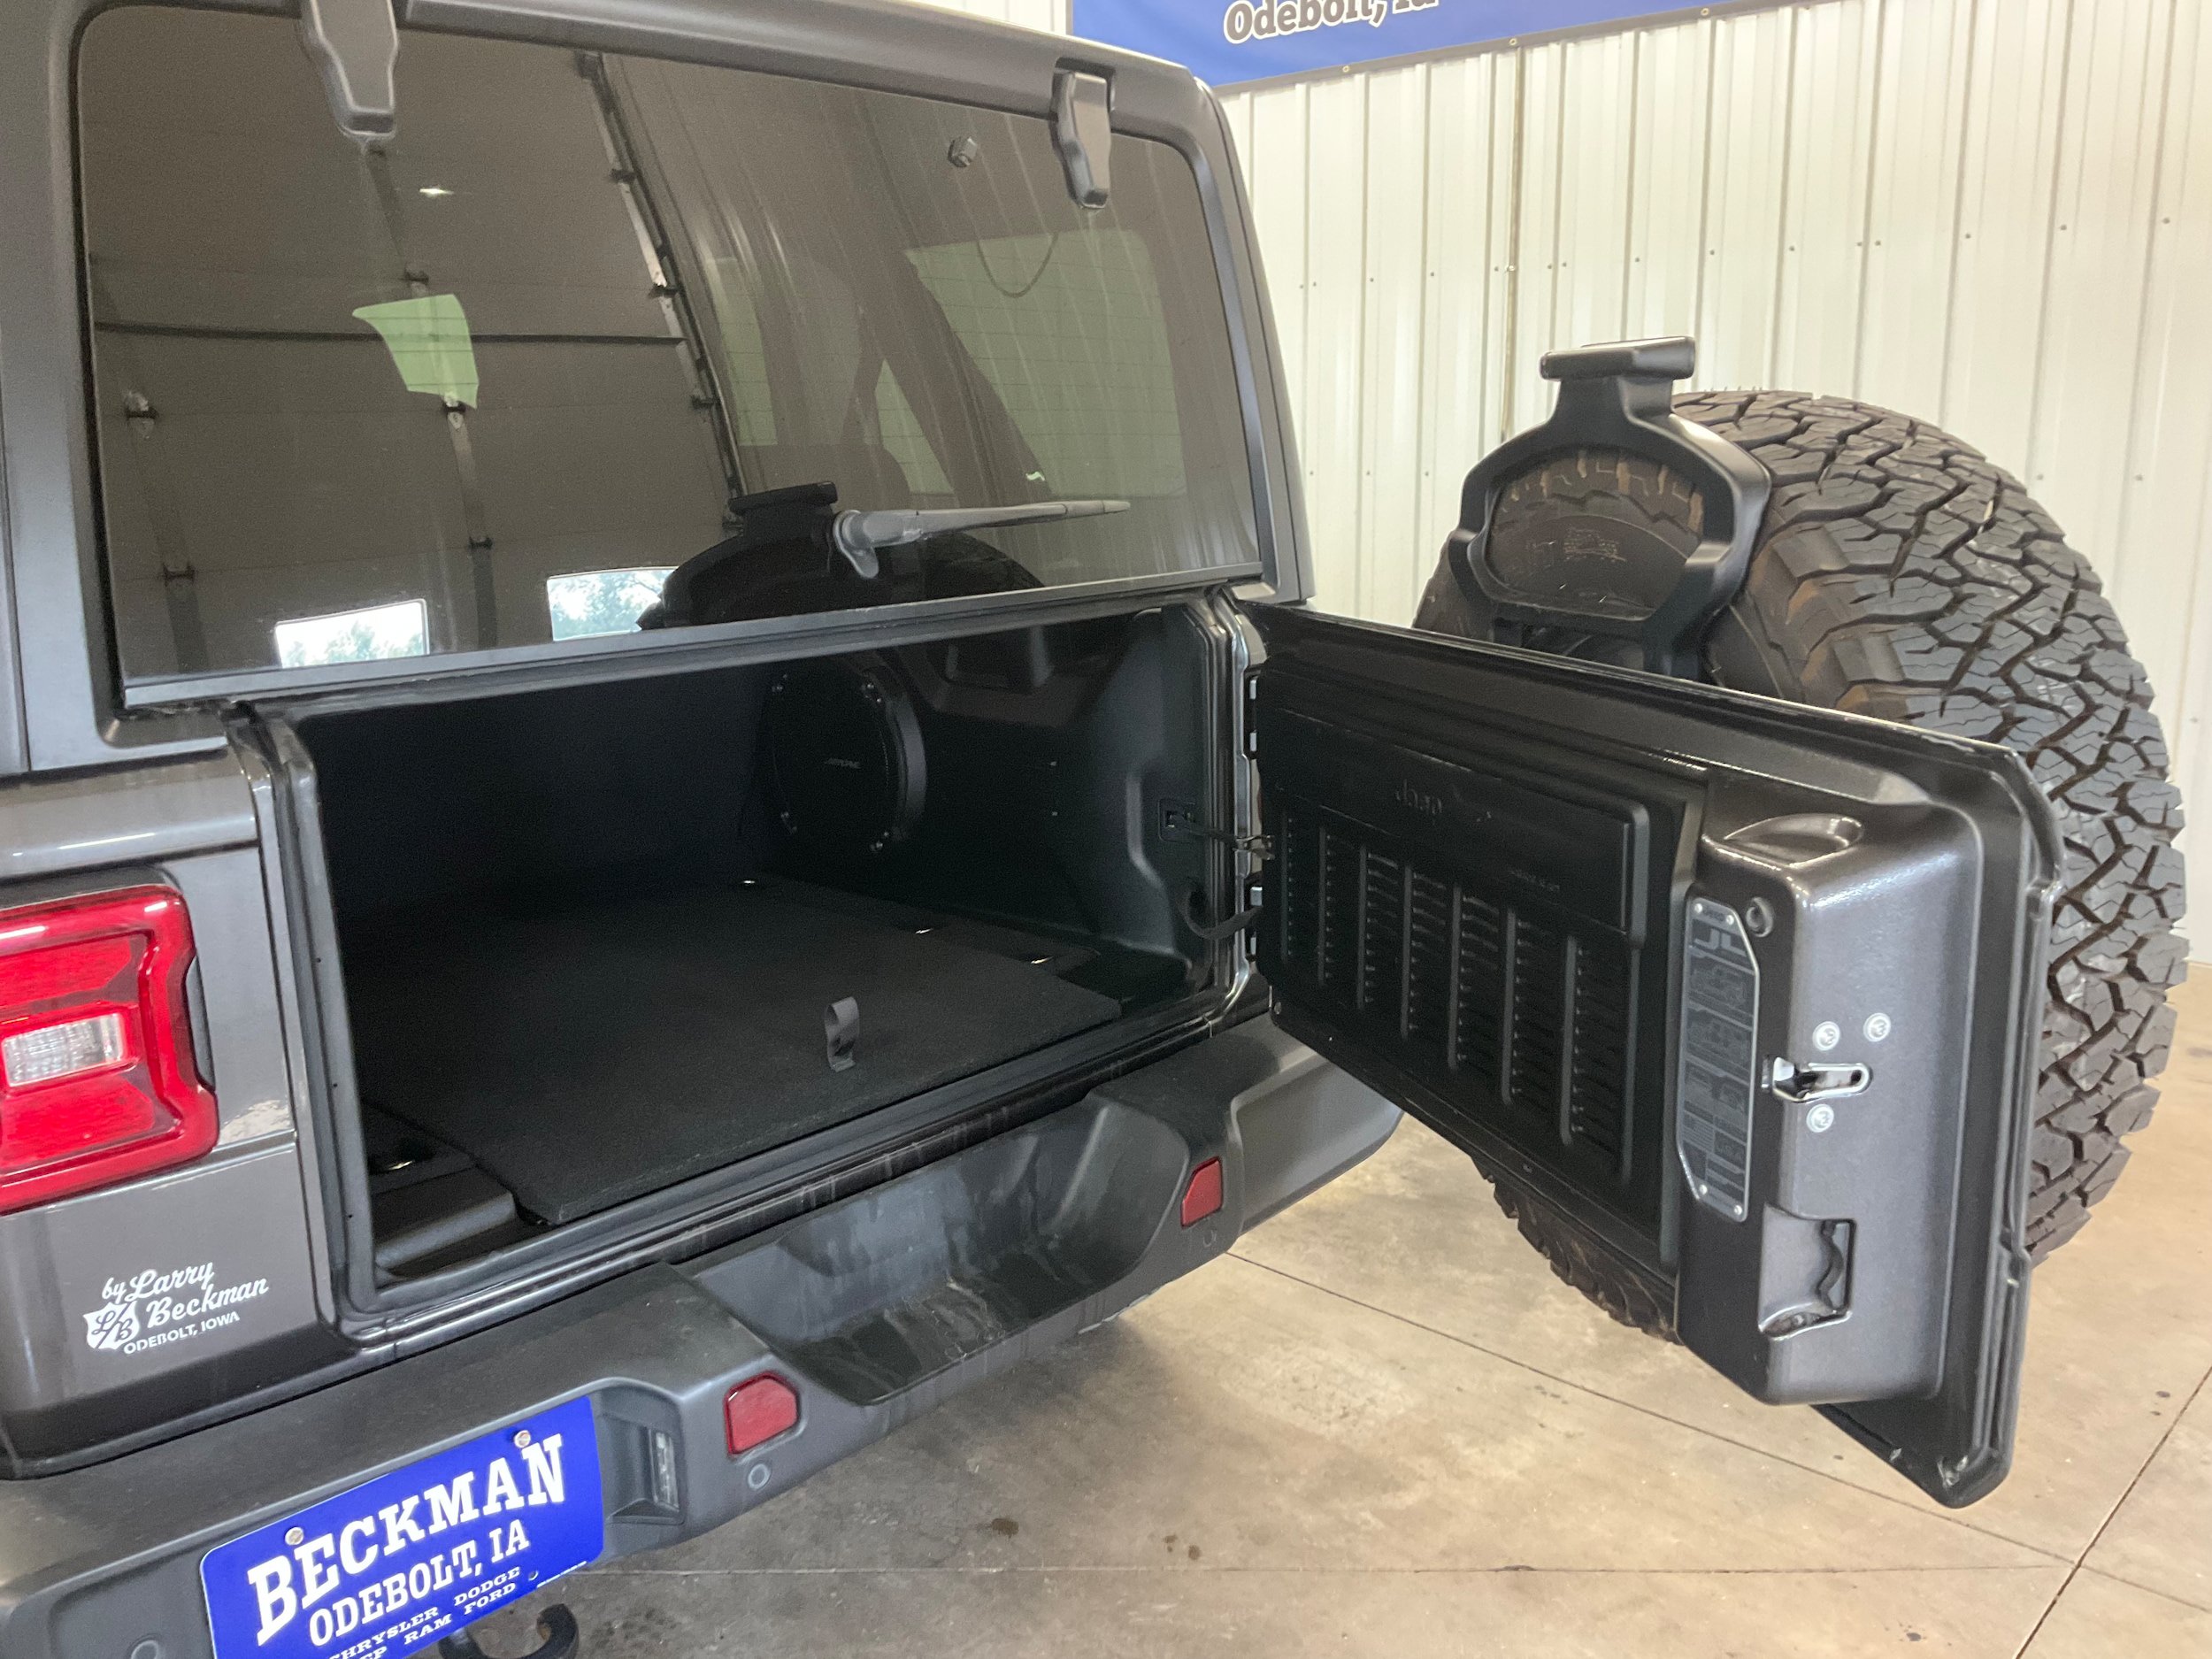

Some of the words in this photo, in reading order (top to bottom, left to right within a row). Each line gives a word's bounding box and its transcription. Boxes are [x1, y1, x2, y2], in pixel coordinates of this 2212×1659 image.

[1694, 928, 1747, 957] JL
[101, 1277, 127, 1304] by
[125, 1262, 215, 1302] Larry
[146, 1278, 269, 1328] Beckman
[123, 1324, 197, 1355] ODEBOLT,
[202, 1310, 240, 1332] IOWA
[248, 1433, 565, 1647] BECKMAN
[309, 1540, 482, 1647] ODEBOLT,
[488, 1518, 529, 1563] IA
[453, 1565, 521, 1607] DODGE
[403, 1613, 452, 1645] RAM
[463, 1582, 517, 1616] FORD
